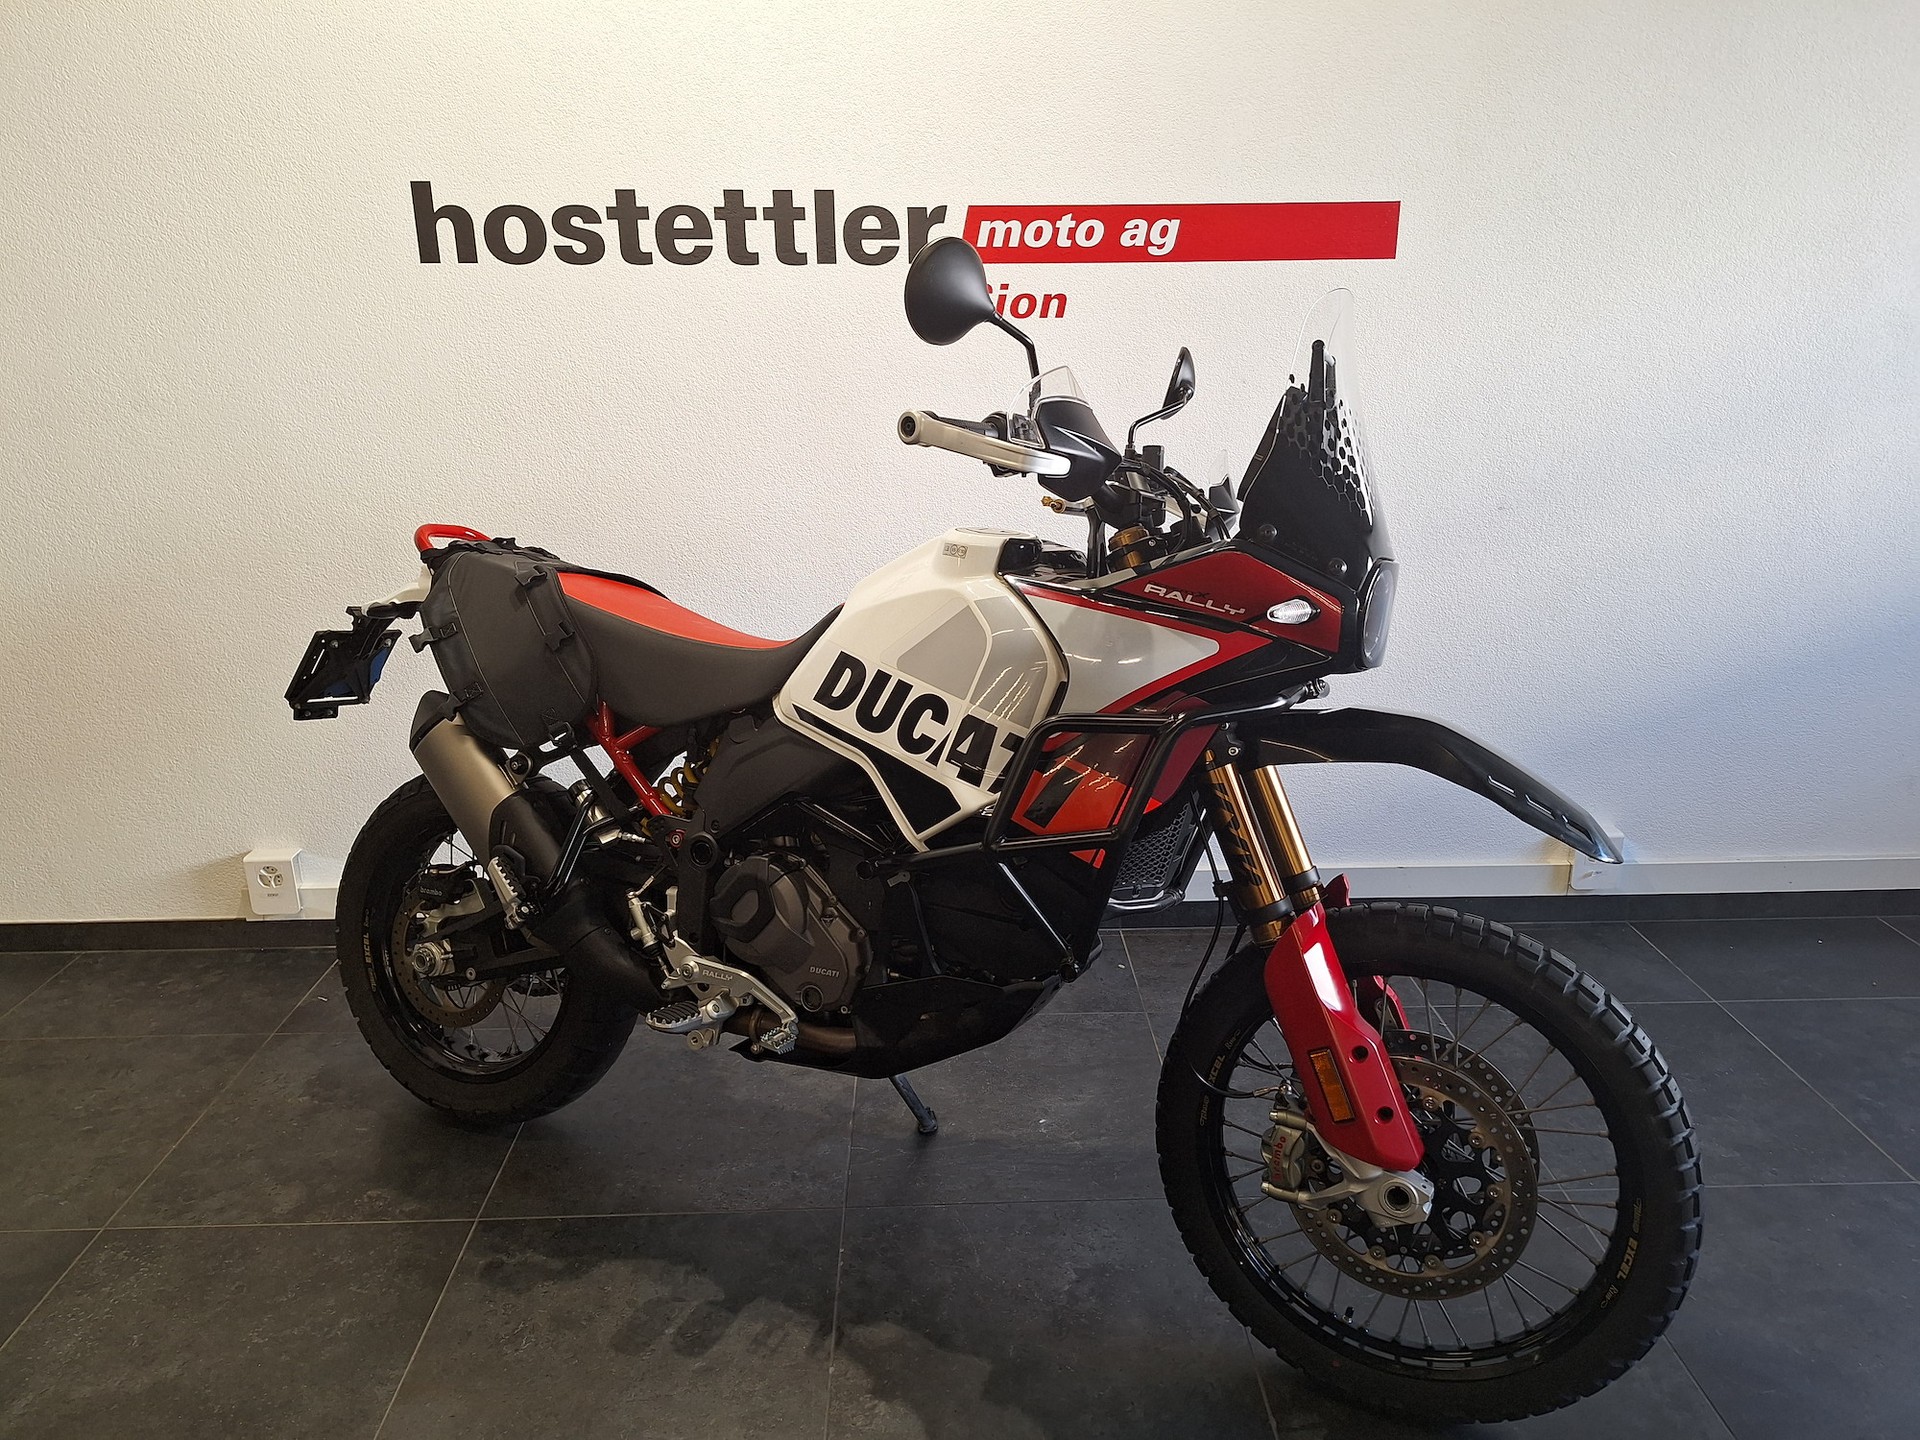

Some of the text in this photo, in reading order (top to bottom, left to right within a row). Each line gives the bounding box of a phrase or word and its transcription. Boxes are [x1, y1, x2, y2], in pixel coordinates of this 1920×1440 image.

[410, 181, 947, 265] hostettler
[976, 211, 1181, 256] moto ag
[986, 283, 1067, 319] ion
[1143, 583, 1246, 615] RALLY
[702, 969, 734, 981] RALLY
[809, 966, 840, 978] DUCATI
[1207, 1053, 1226, 1086] XCEL
[1616, 1237, 1639, 1280] EXCEL
